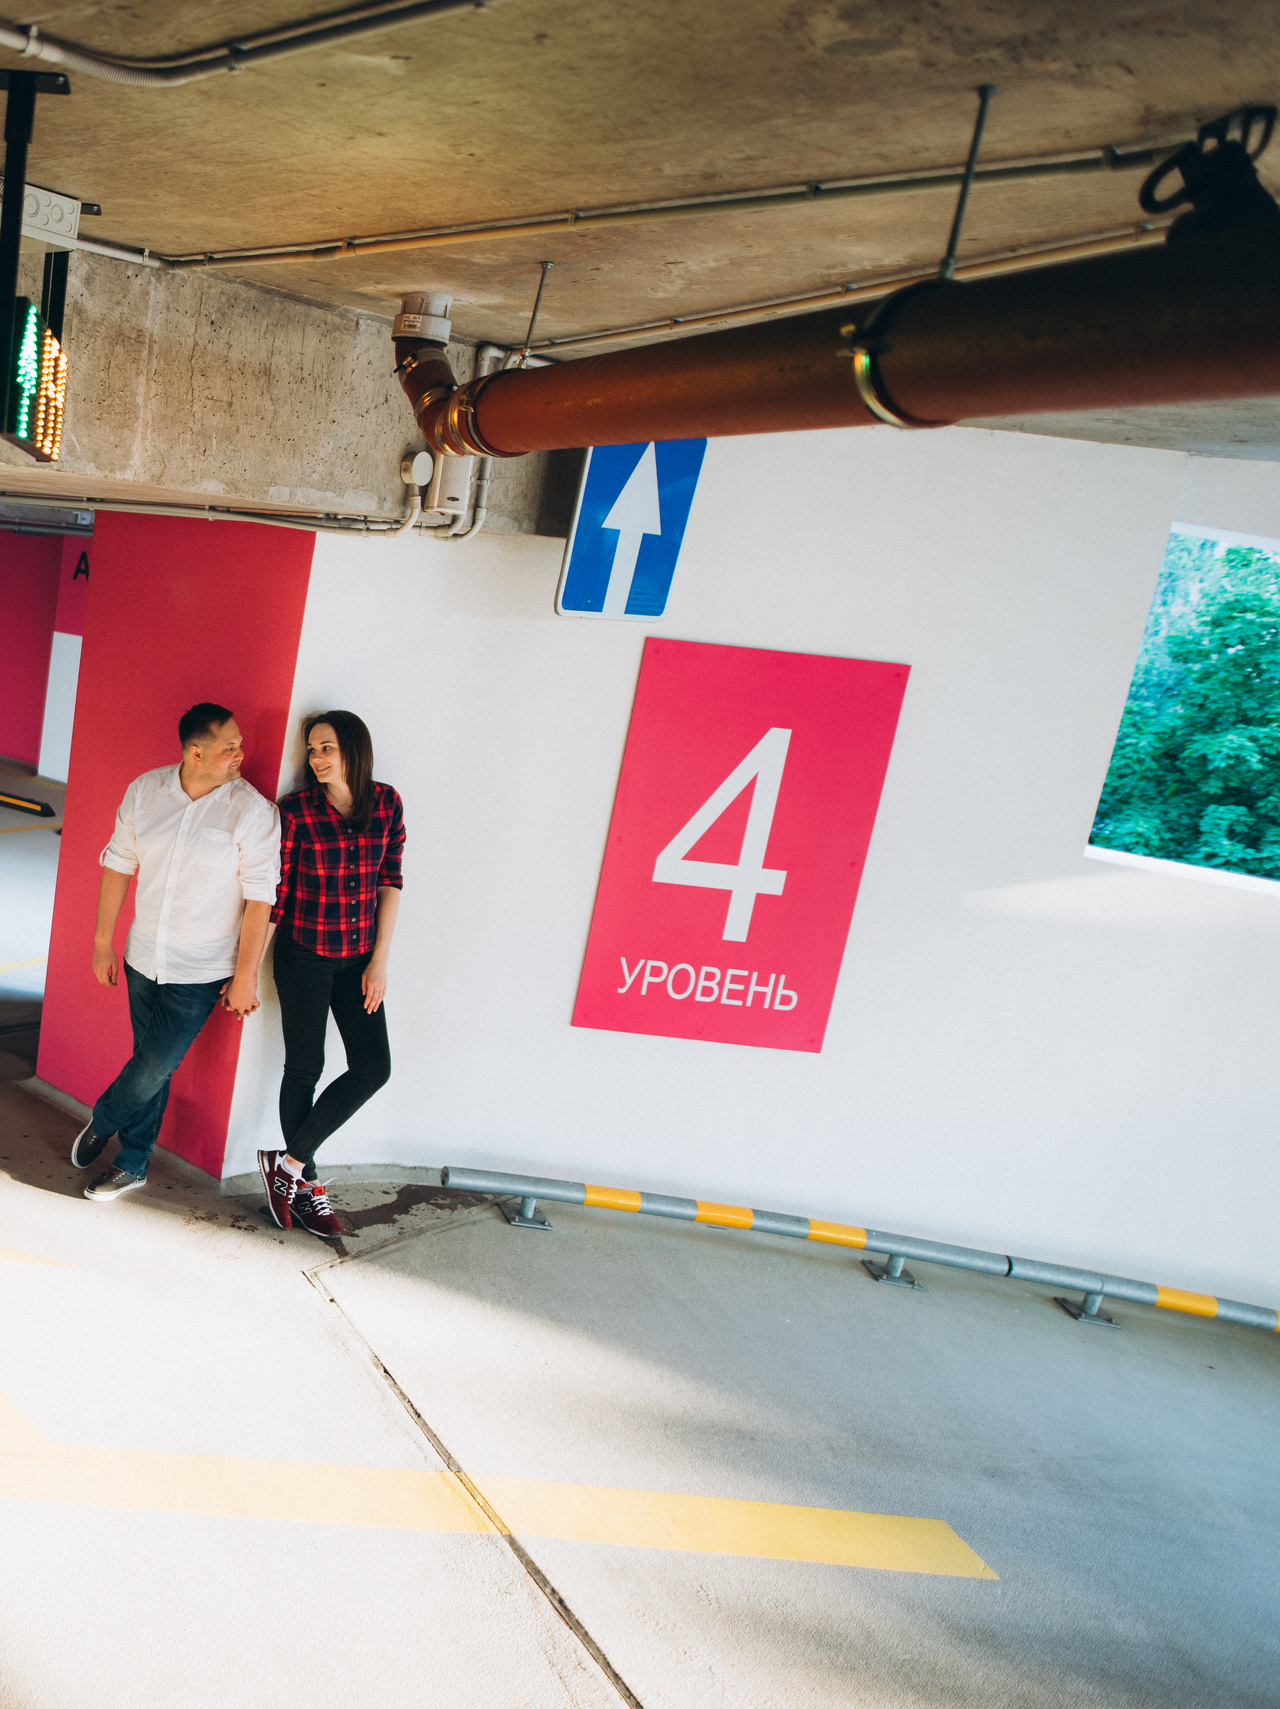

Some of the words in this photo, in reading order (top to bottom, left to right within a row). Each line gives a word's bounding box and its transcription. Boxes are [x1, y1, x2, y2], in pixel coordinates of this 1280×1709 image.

[73, 551, 90, 581] A
[652, 726, 792, 943] 4
[617, 957, 799, 1012] УРОВЕНЬ
[274, 1176, 288, 1196] N
